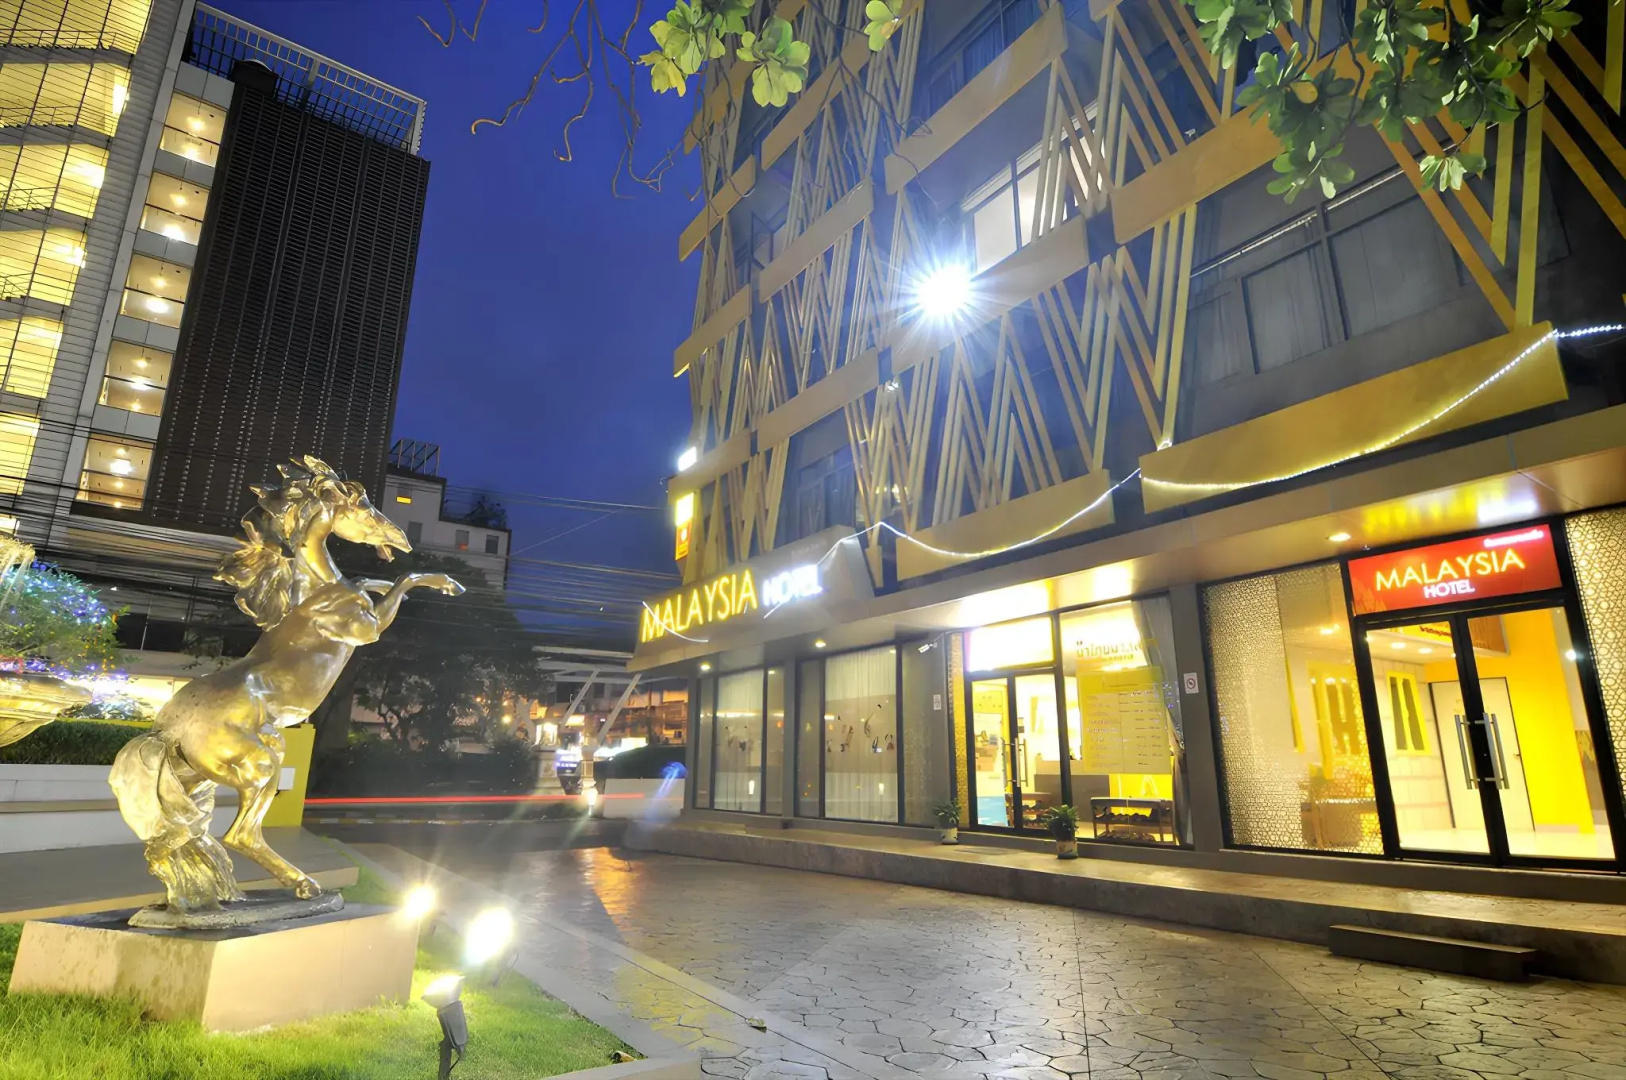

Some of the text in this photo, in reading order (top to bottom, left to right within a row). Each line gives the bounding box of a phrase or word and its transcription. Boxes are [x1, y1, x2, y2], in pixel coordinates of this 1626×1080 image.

[1375, 548, 1525, 591] MALAYSIA
[1423, 579, 1475, 599] HOTEL
[640, 564, 823, 643] MALAYSIA HOTEL
